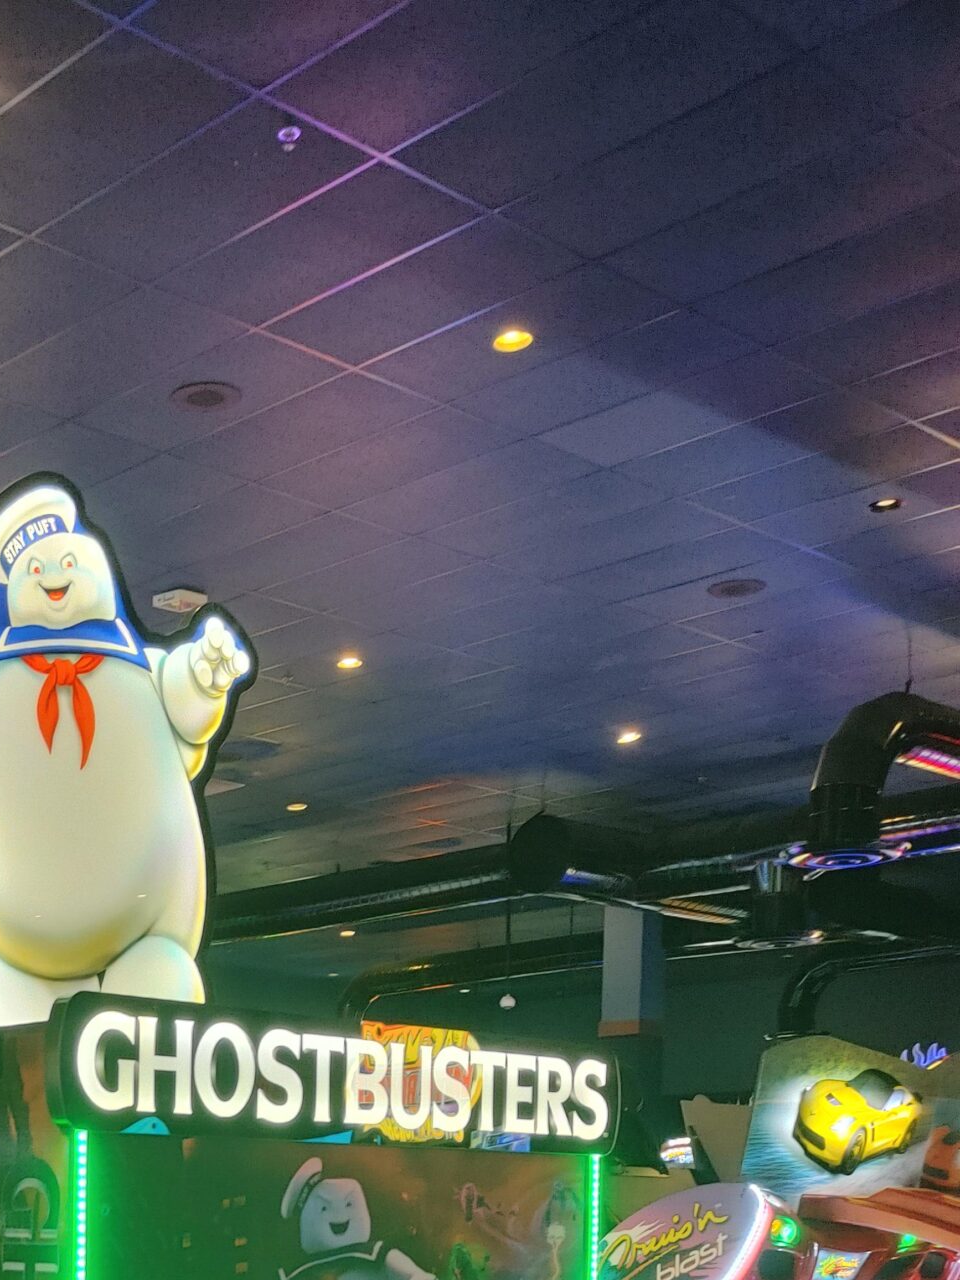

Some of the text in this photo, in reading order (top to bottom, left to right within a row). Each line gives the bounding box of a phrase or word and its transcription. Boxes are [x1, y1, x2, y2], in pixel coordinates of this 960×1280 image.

[3, 517, 58, 565] STAY PUFT
[76, 1010, 608, 1141] GHOSTBUSTERS
